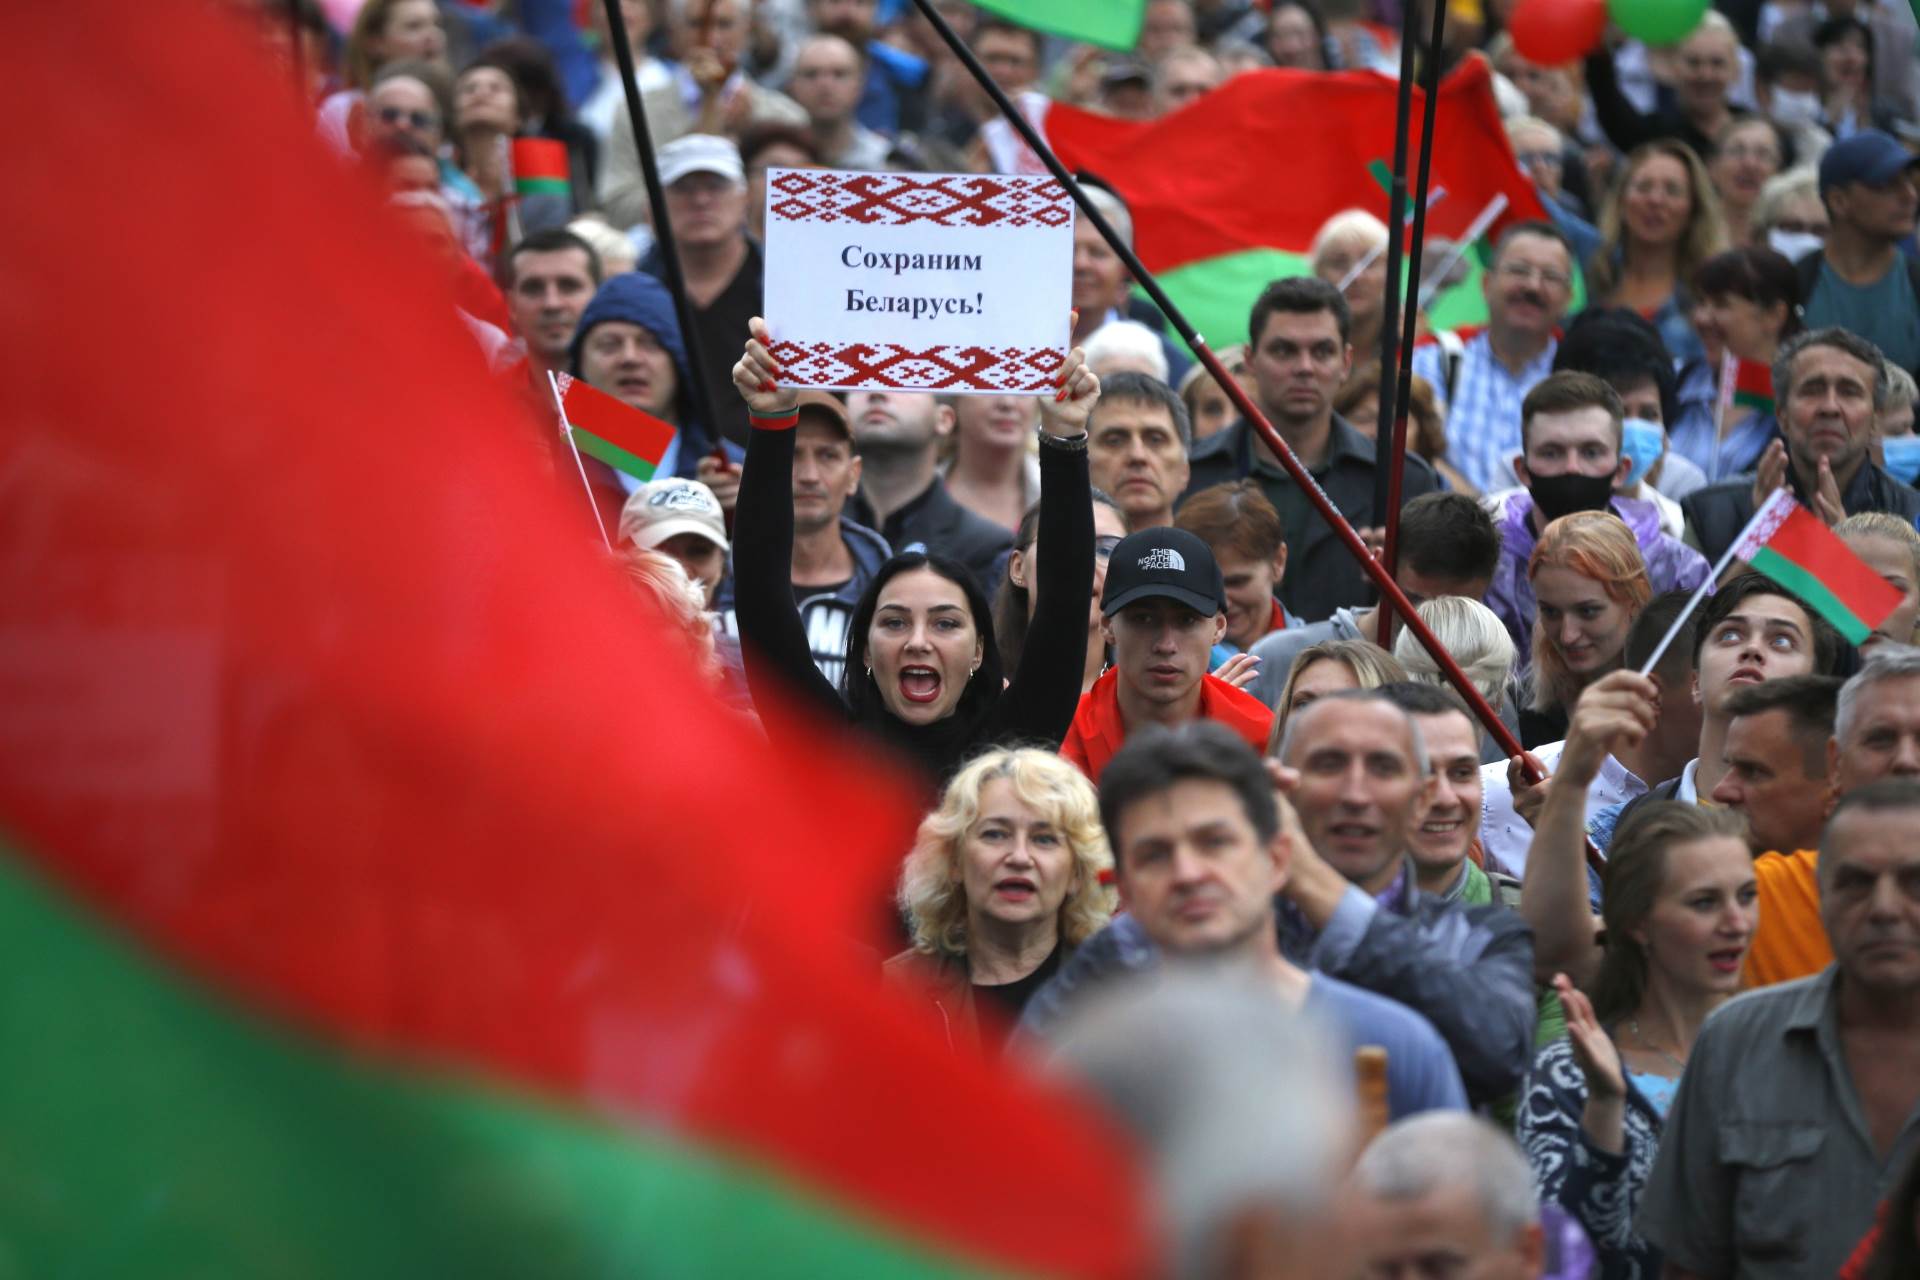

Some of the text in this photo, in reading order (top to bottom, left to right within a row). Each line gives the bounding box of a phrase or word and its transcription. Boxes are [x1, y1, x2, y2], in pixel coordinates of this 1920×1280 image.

[841, 244, 982, 275] Сохраним
[846, 288, 983, 320] Беларусь!
[1150, 548, 1171, 556] THE
[1138, 555, 1170, 566] NORTH
[1144, 561, 1170, 570] FACE
